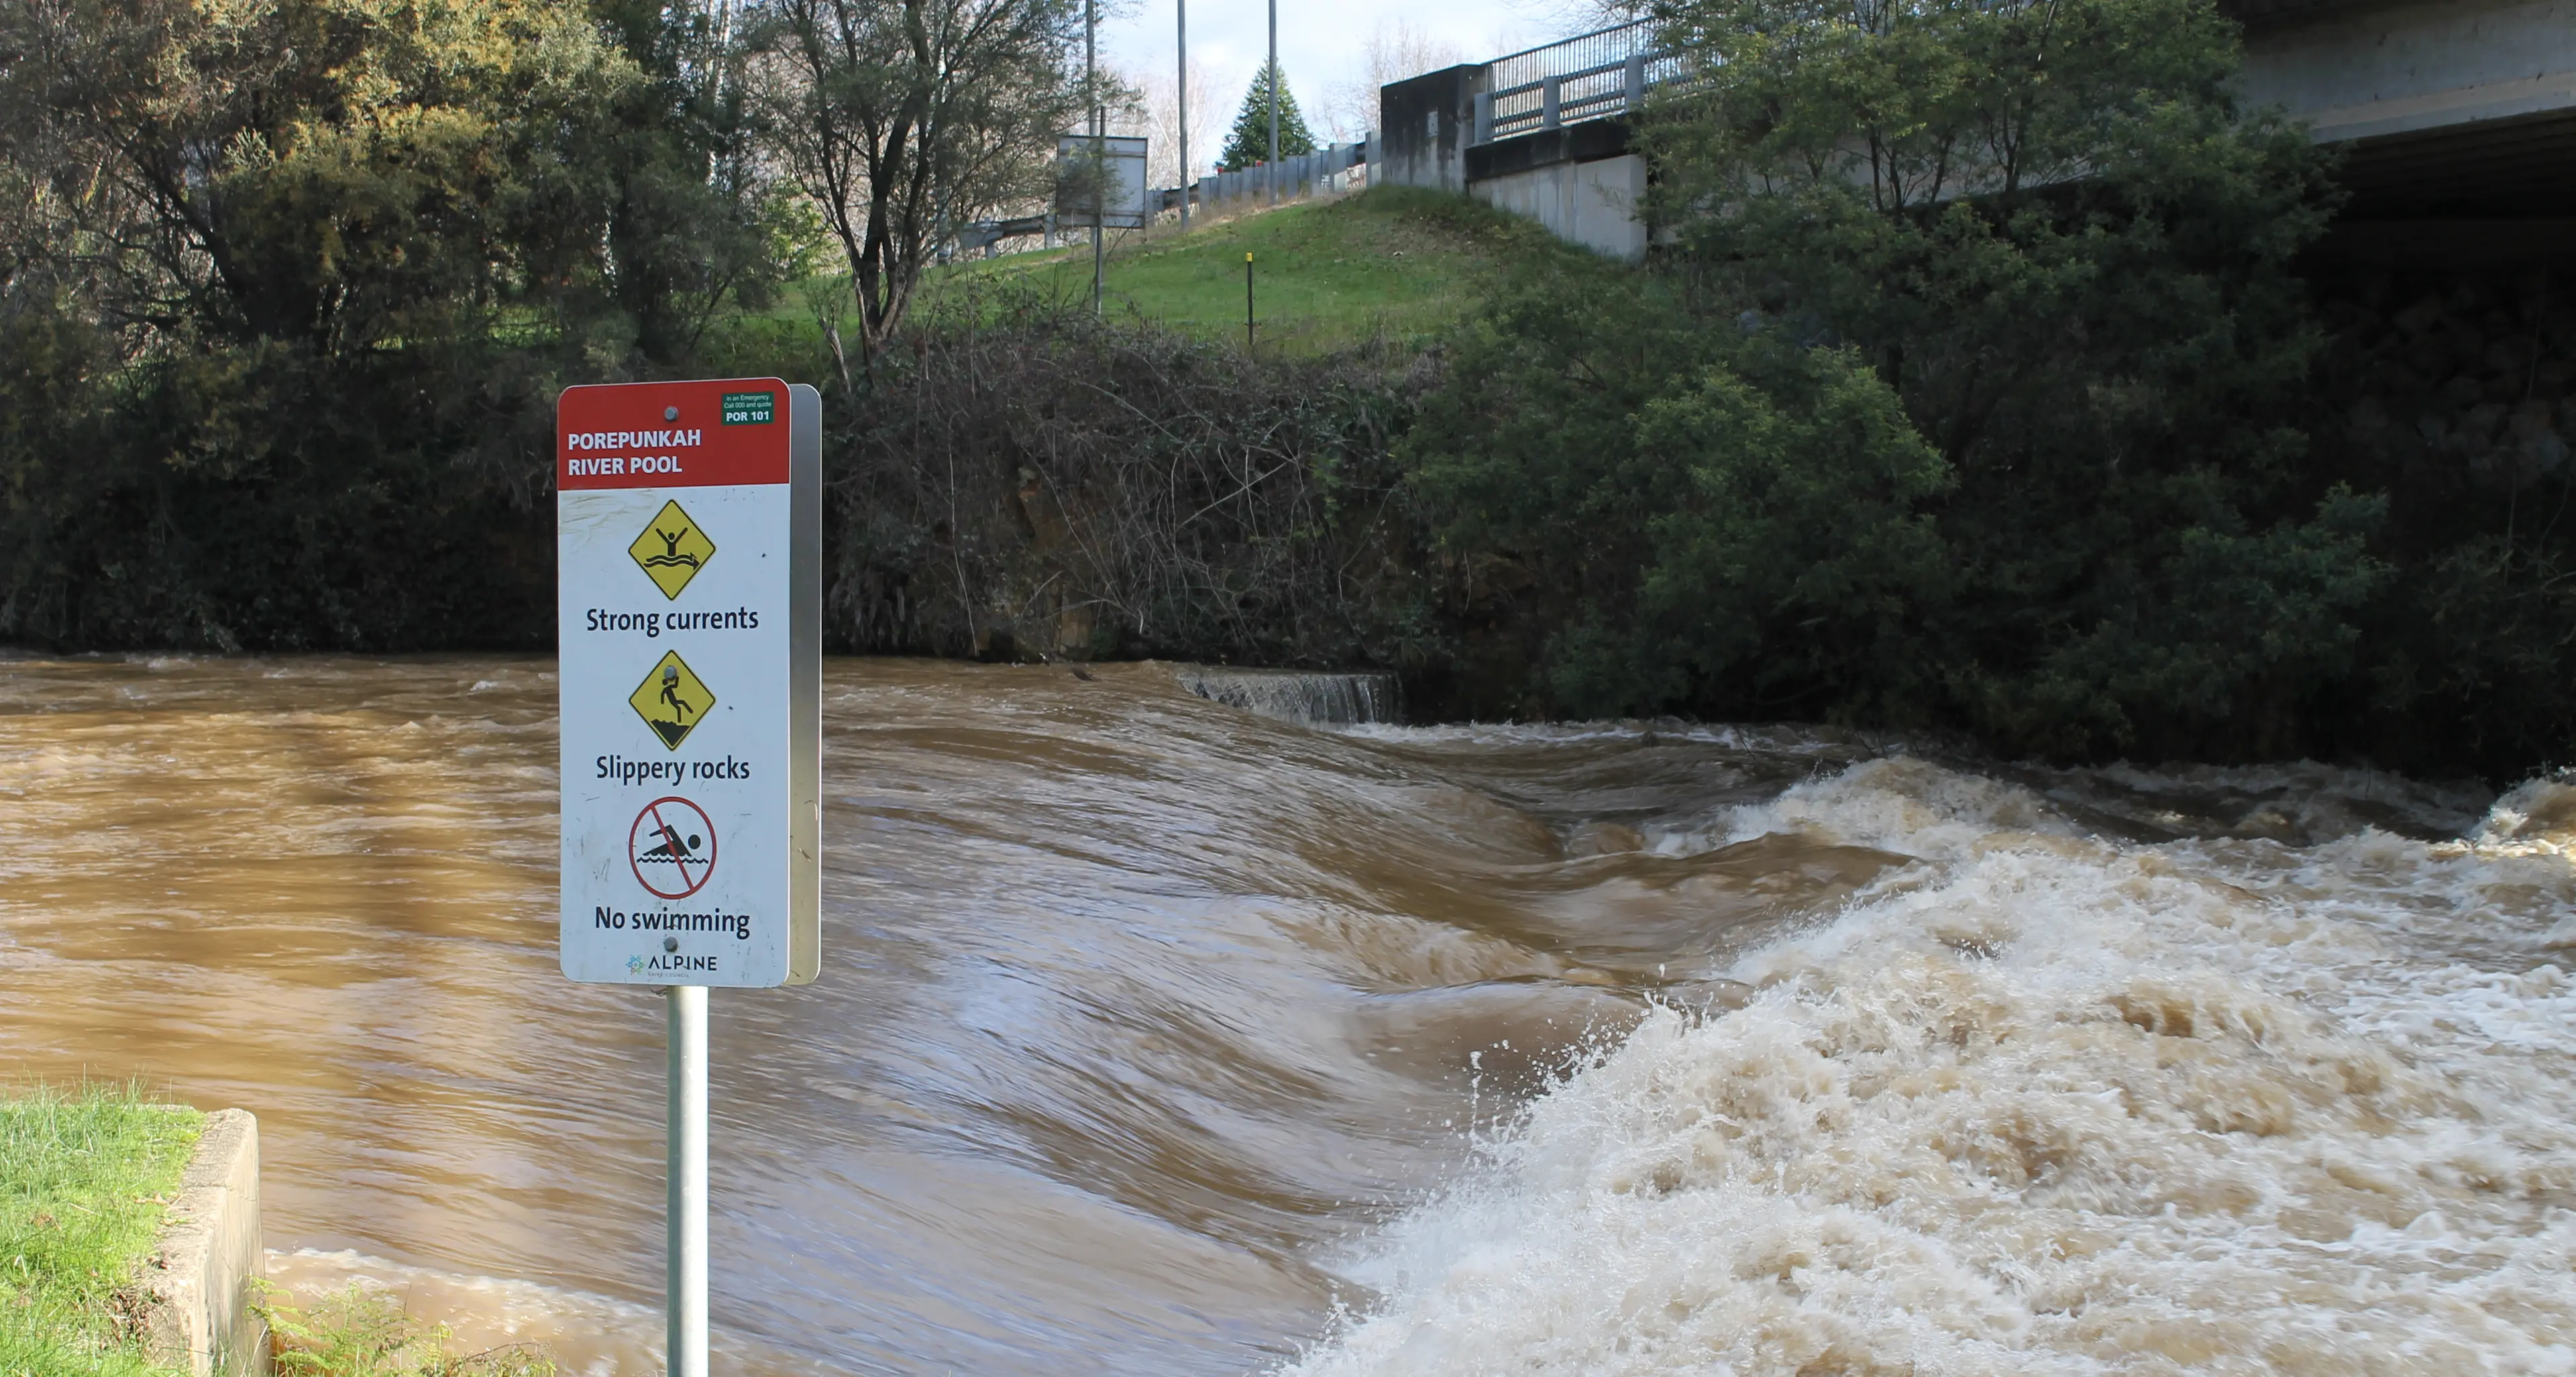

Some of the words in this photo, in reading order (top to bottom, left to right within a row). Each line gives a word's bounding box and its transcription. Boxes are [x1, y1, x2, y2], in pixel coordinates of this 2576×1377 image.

[727, 412, 747, 422] POR
[751, 410, 769, 421] 101
[568, 429, 701, 450] POREPUNKAH
[568, 458, 624, 476] RIVER
[630, 456, 682, 474] POOL
[587, 609, 659, 638] Strong
[666, 607, 759, 629] currents
[596, 755, 686, 786] Slippery
[693, 755, 750, 779] rocks
[596, 907, 625, 929] No
[632, 907, 750, 940] swimming
[648, 955, 717, 971] ALPINE
